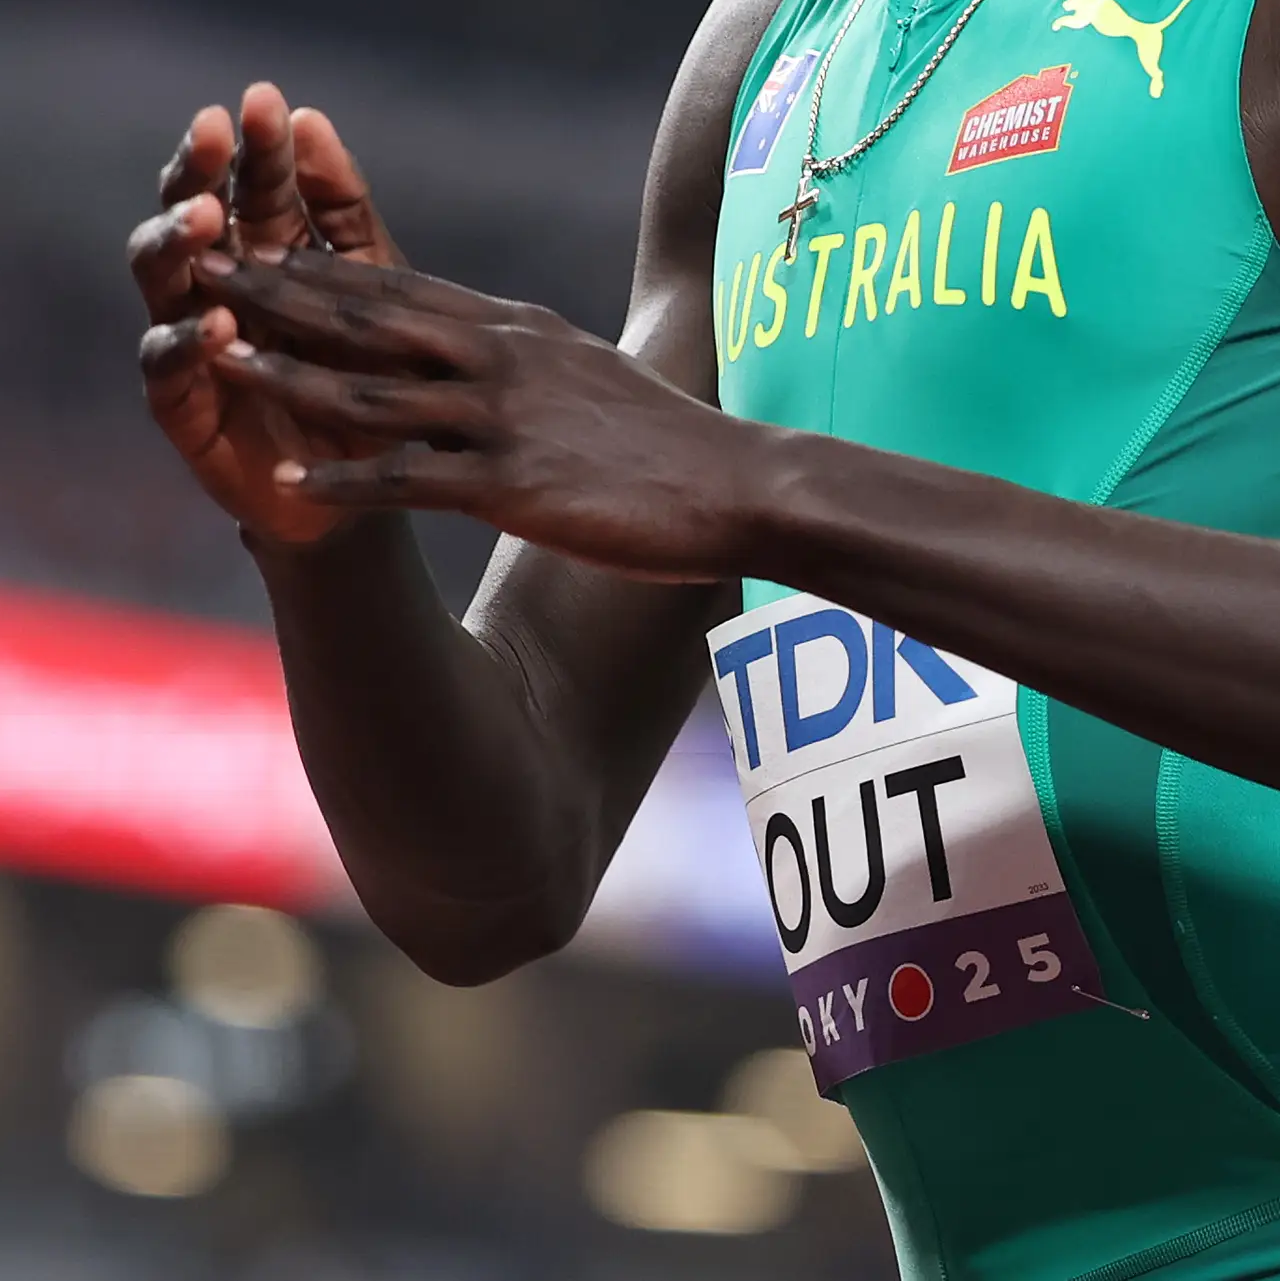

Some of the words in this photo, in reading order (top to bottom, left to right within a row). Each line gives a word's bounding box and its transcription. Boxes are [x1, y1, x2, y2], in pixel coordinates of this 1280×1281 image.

[963, 96, 1062, 143] CHEMIST
[957, 126, 1051, 161] WAREHOUSE
[714, 608, 978, 771] TDK
